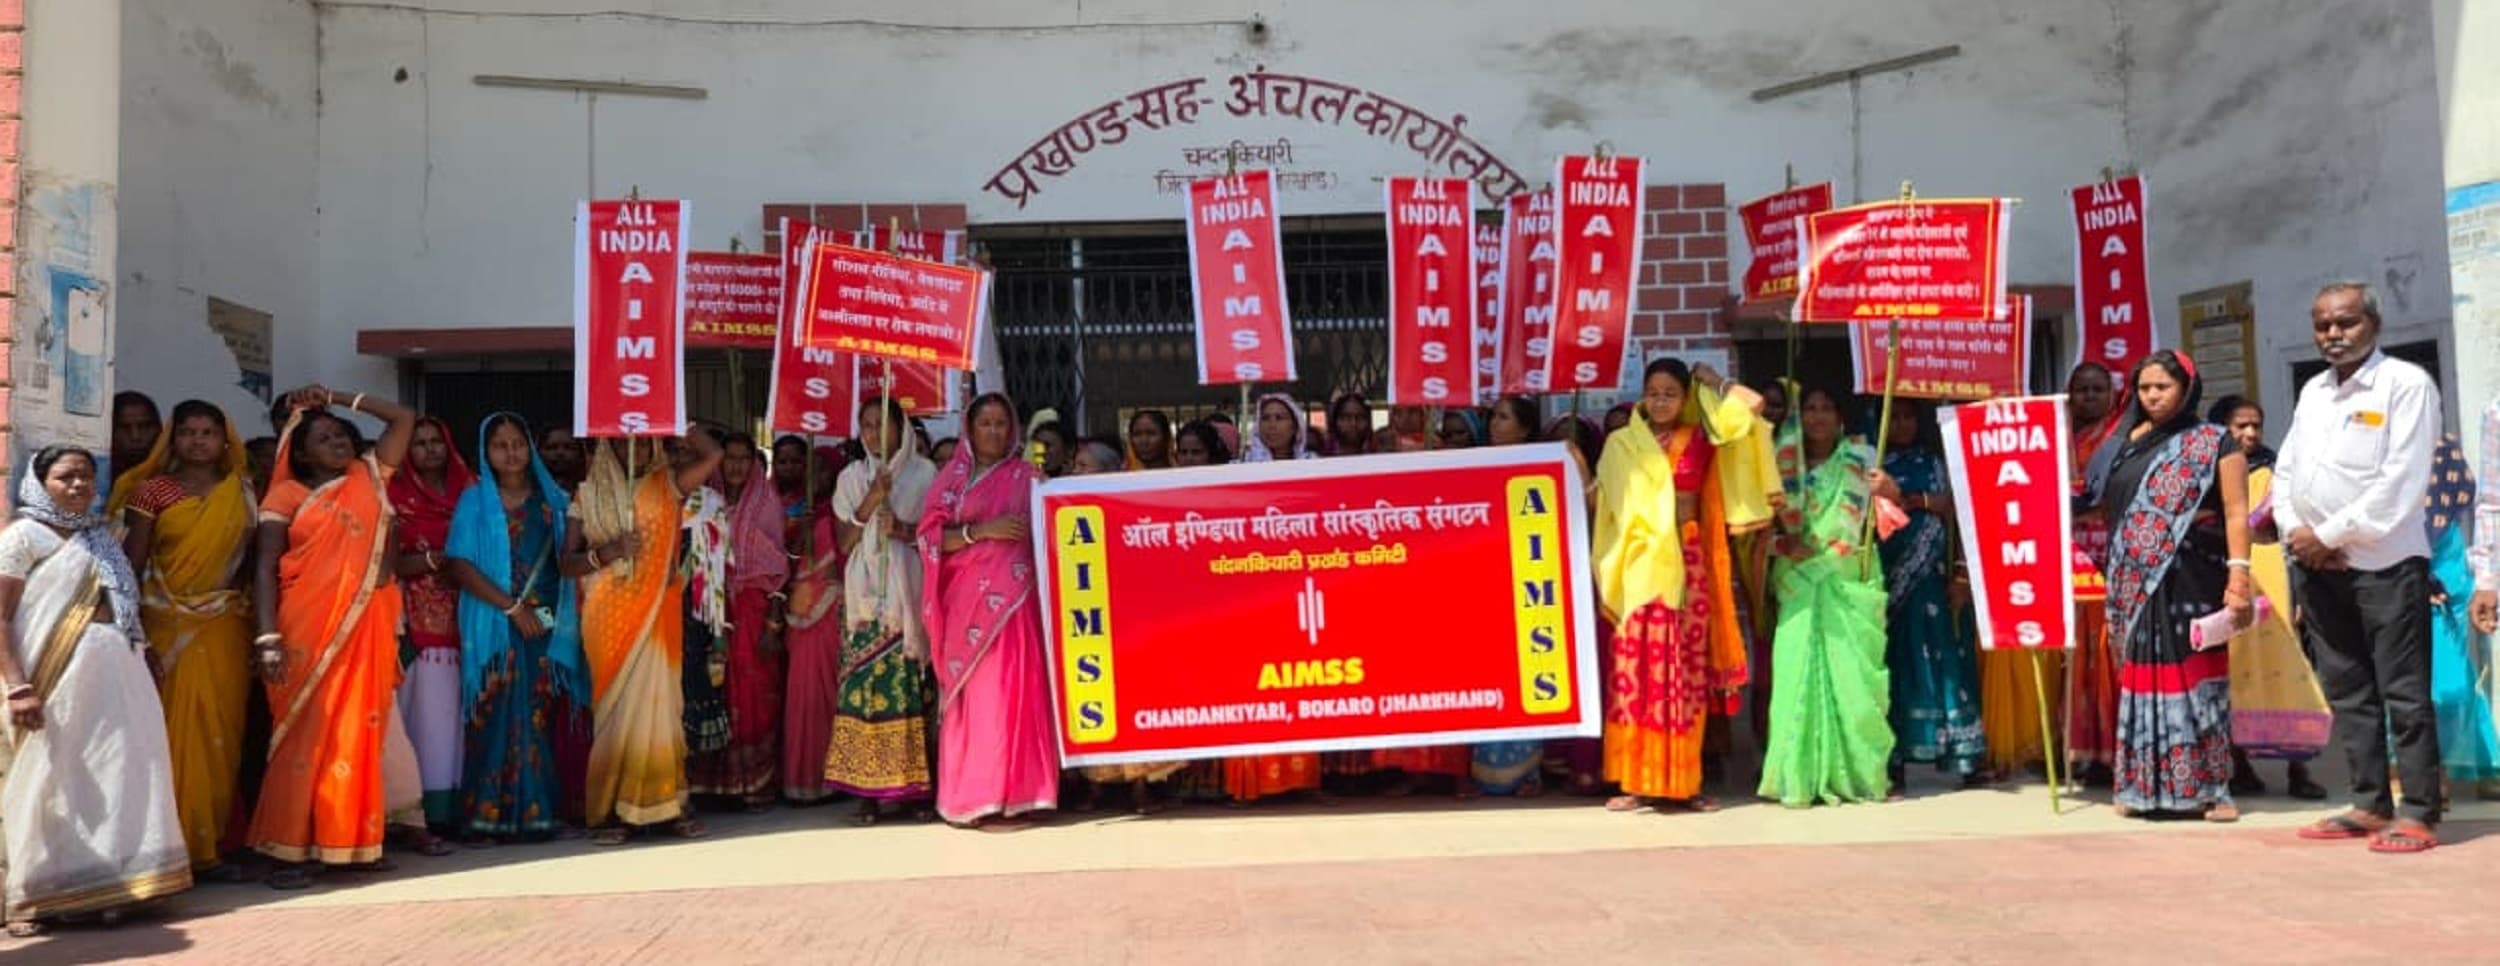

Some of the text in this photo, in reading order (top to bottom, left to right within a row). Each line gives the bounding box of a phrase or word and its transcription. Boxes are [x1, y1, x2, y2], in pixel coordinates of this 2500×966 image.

[1583, 156, 1619, 178] ALL
[1214, 176, 1248, 200] ALL
[1413, 178, 1448, 200] ALL
[1570, 182, 1631, 206] INDIA
[2092, 181, 2124, 205] ALL
[616, 204, 656, 225] ALL
[1201, 198, 1266, 225] INDIA
[1399, 204, 1462, 226] INDIA
[2083, 202, 2138, 231] INDIA
[600, 230, 672, 252] INDIA
[1222, 228, 1263, 381] AIMSS
[1574, 214, 1613, 382] AIMSS
[1853, 303, 1941, 317] AIMSS
[1417, 234, 1450, 398] AIMSS
[616, 262, 655, 434] AIMSS
[836, 335, 938, 361] AIMSS
[1896, 380, 1992, 397] AIMSS
[1984, 402, 2029, 425] ALL
[1971, 426, 2050, 456] INDIA
[1121, 516, 1172, 549] ऑल
[1251, 506, 1319, 542] महिला
[1321, 498, 1423, 540] सांस्कृतिक
[1424, 497, 1491, 530] संगठन
[1209, 549, 1303, 575] चंदनकियारी
[1354, 543, 1408, 567] कमिटी
[1997, 460, 2046, 645] AIMSS
[1520, 488, 1558, 700] AIMSS
[1067, 516, 1105, 729] AIMSS
[1257, 657, 1365, 690] AIMSS
[1134, 688, 1505, 729] CHANDANKIYARI, BOKARO (JHARKHAND)
